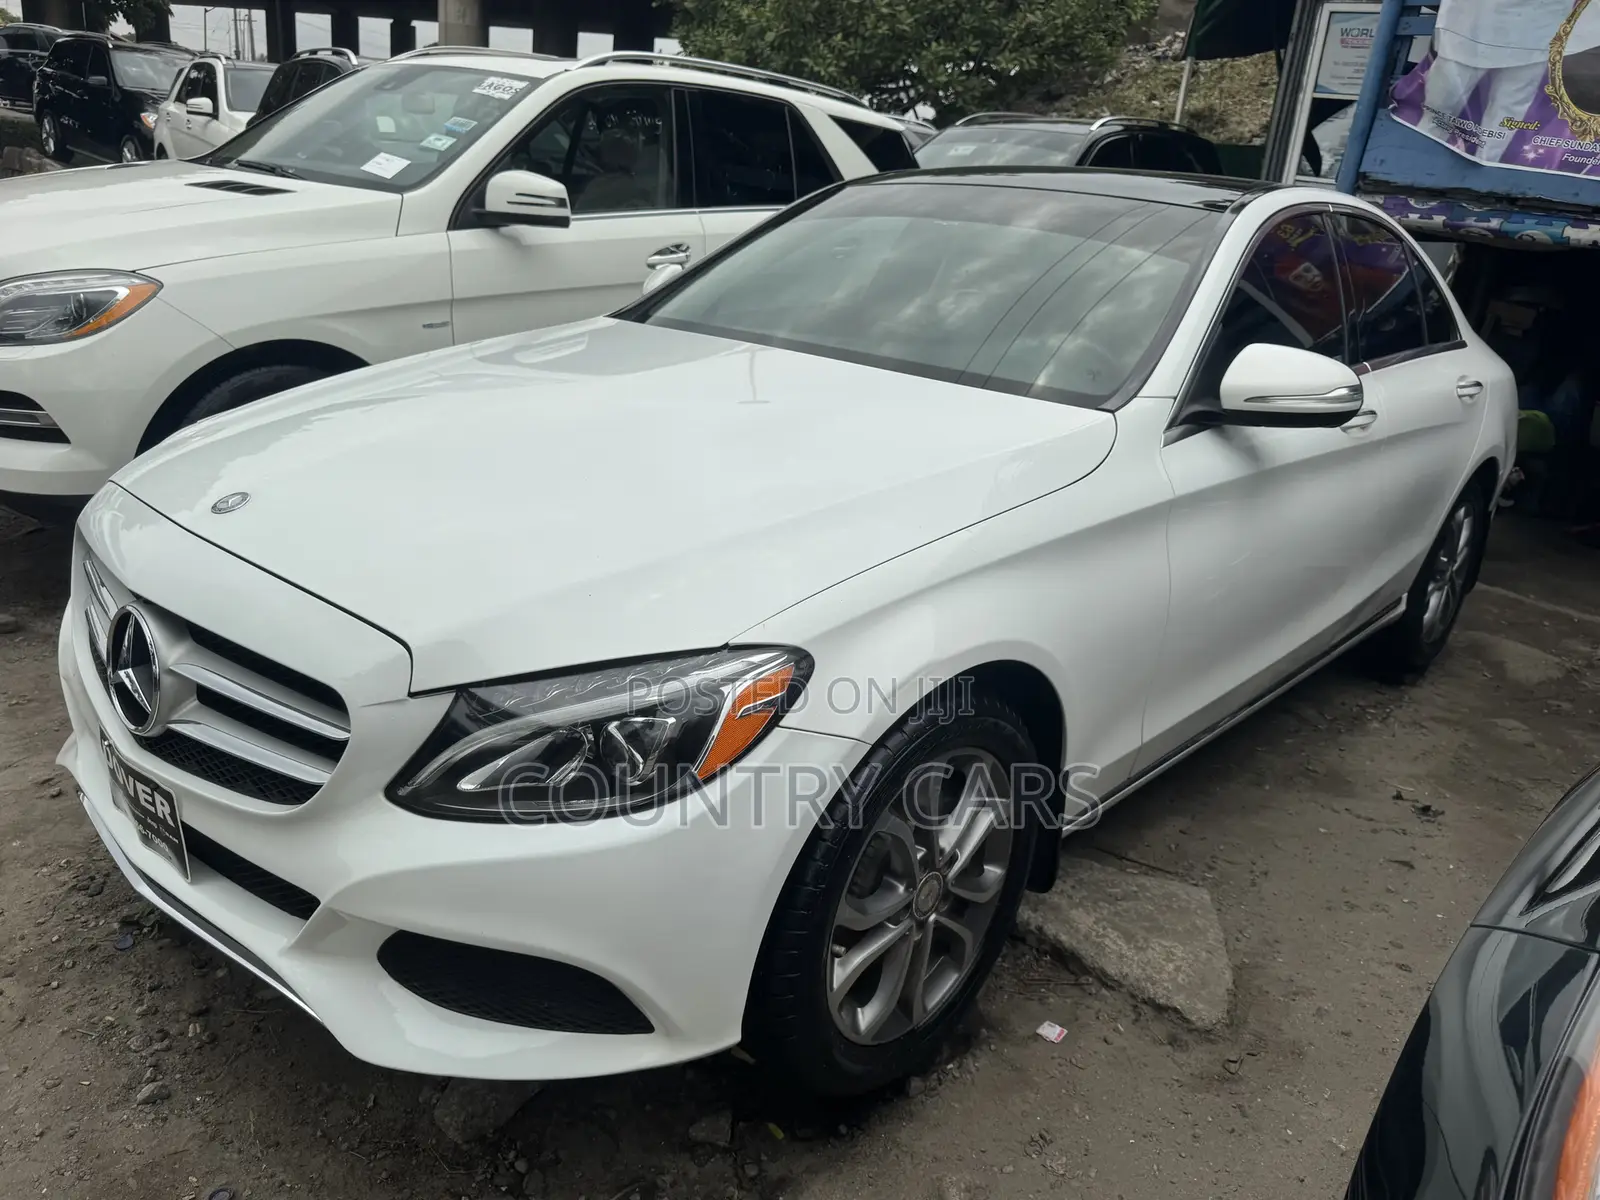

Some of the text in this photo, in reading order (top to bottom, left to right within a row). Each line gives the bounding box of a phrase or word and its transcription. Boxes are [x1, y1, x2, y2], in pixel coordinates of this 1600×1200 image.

[1340, 27, 1374, 38] WORL
[1499, 116, 1540, 131] Signed:
[1532, 135, 1600, 153] CHIEF SUNDA
